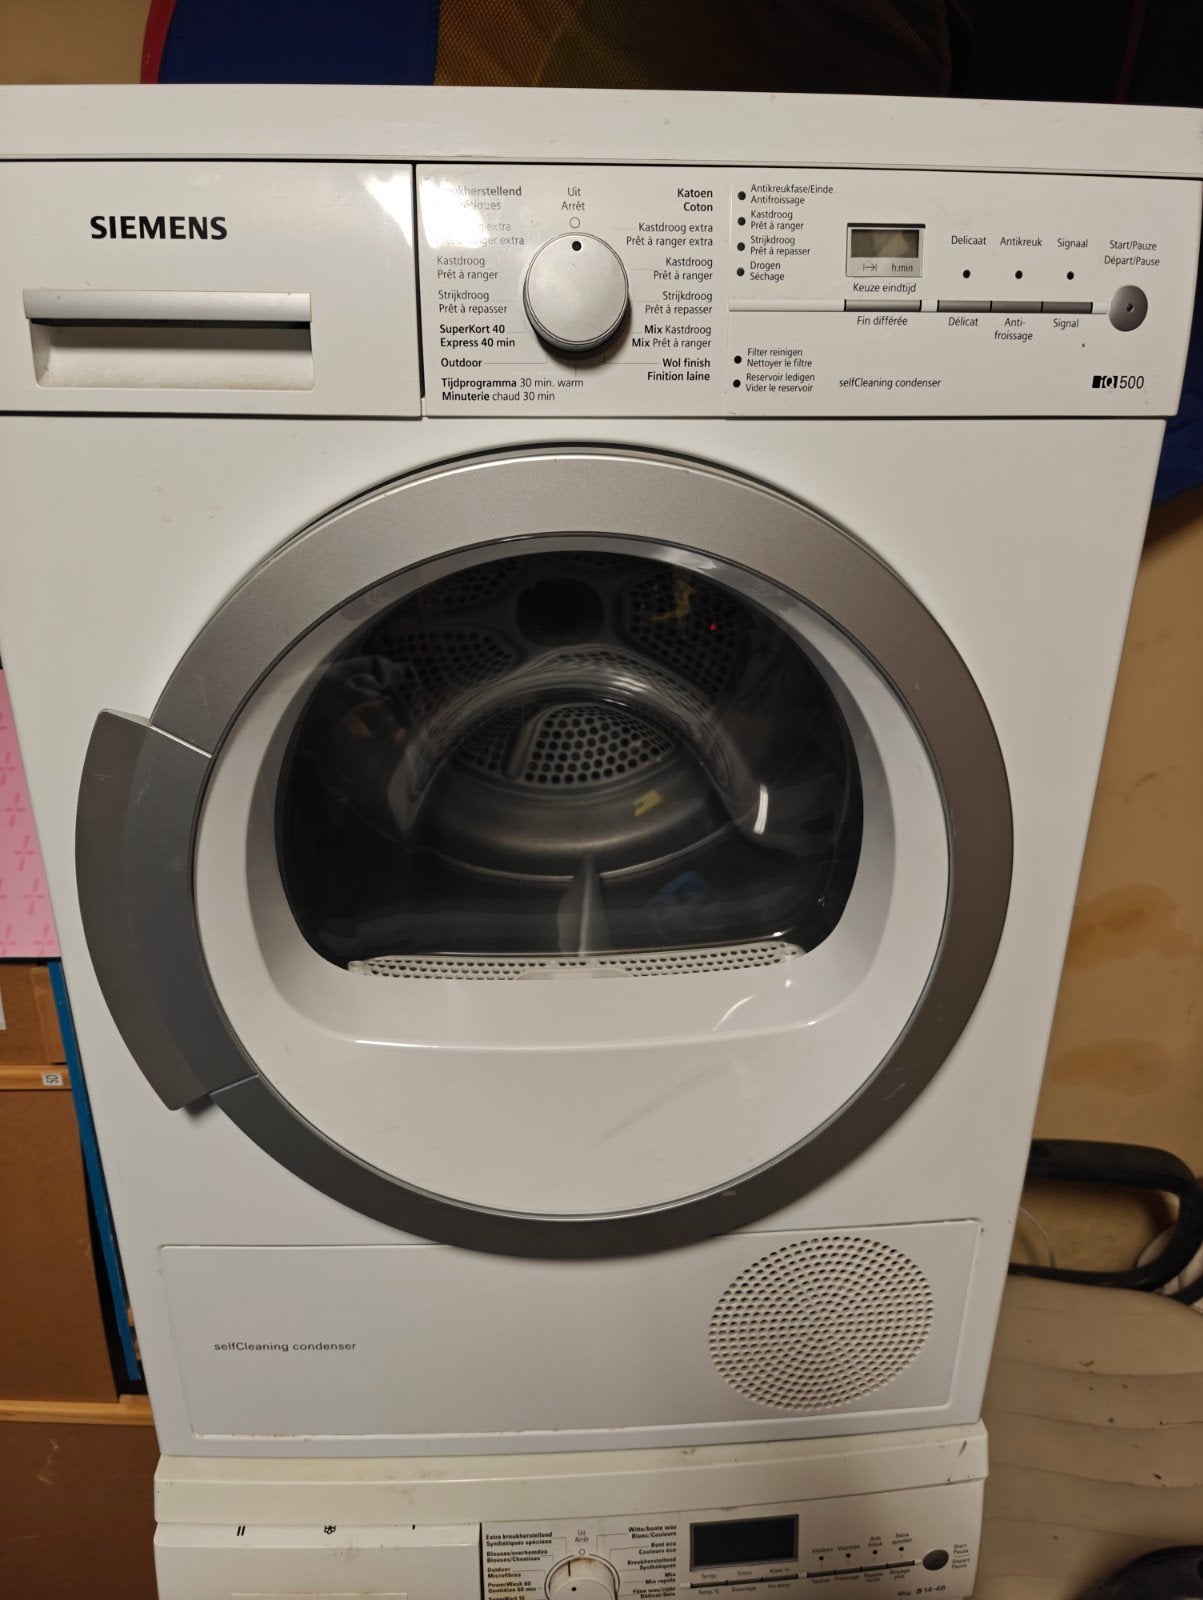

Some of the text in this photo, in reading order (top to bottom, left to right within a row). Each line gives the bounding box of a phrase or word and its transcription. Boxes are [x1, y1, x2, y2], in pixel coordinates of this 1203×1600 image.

[567, 186, 582, 197] Uit
[677, 188, 713, 198] Katoen
[750, 184, 834, 194] Antikreukfase/Einde
[561, 200, 586, 211] Arrêt
[750, 195, 805, 206] Antifroissage
[683, 202, 713, 212] Coton
[750, 210, 793, 220] Kastdroog
[90, 215, 228, 240] SIEMENS
[487, 223, 512, 231] extra
[638, 222, 713, 234] Kastdroog extra
[750, 221, 804, 231] Prêt à ranger
[500, 236, 525, 245] extra
[626, 236, 713, 248] Prêt à ranger extra
[750, 236, 796, 246] Strijkdroog
[951, 235, 987, 246] Delicaat
[1000, 237, 1043, 247] Antikreuk
[1057, 238, 1088, 249] Signaal
[1109, 240, 1158, 251] Start/Pauze
[750, 246, 811, 257] Prêt à repasser
[437, 256, 486, 268] Kastdroog
[665, 257, 713, 269] Kastdroog
[750, 261, 781, 271] Drogen
[1104, 255, 1160, 267] Départ/Pause
[891, 262, 914, 273] h:min
[437, 269, 499, 281] Prêt à ranger
[653, 270, 713, 283] Prêt à ranger
[749, 272, 785, 283] Séchage
[853, 282, 917, 296] Keuze eindtijd
[438, 290, 490, 302] Strijkdroog
[662, 290, 713, 303] Strijkdroog
[439, 303, 508, 316] Prêt à repasser
[645, 304, 713, 316] Prêt à repasser
[857, 315, 909, 327] Fin différée
[948, 316, 979, 327] Délicat
[1004, 317, 1026, 328] Anti-
[1052, 318, 1080, 329] Signal
[439, 324, 506, 336] SuperKort 40
[644, 324, 712, 337] Mix Kastdroog
[994, 330, 1033, 342] froissage
[440, 338, 516, 349] Express 40 min
[631, 338, 712, 351] Mix Prêt à ranger
[747, 347, 803, 358] Filter reinigen
[440, 358, 482, 368] Outdoor
[662, 358, 711, 368] Wol finish
[746, 358, 813, 370] Nettoyer le filtre
[647, 371, 711, 381] Finition laine
[746, 372, 815, 384] Reservoir ledigen
[441, 377, 584, 390] Tijdprogramma 30 min. warm
[745, 384, 814, 393] Vider le reservoir
[839, 377, 941, 390] selfCleaning condenser
[442, 391, 556, 401] Minuterie chaud 30 min
[214, 1342, 357, 1353] selfCleaning condenser
